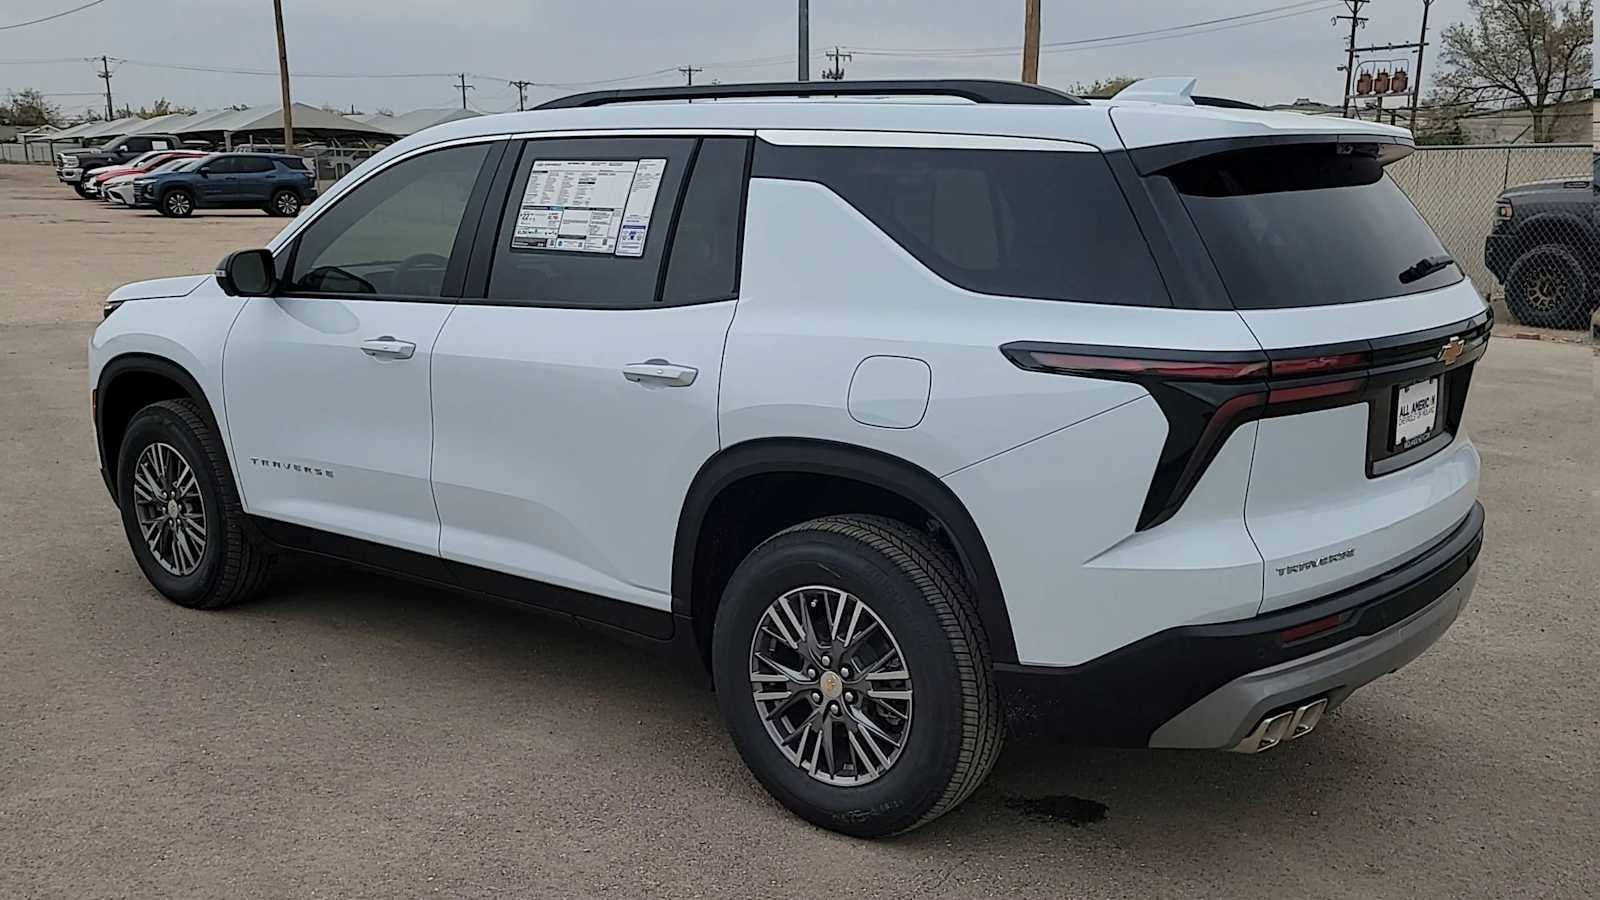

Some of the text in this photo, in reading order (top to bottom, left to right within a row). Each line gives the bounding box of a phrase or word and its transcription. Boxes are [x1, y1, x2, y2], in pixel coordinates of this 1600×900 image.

[1411, 395, 1436, 413] AMERICN
[250, 457, 334, 478] TRAVERSE
[1275, 549, 1355, 576] TRAVERSE
